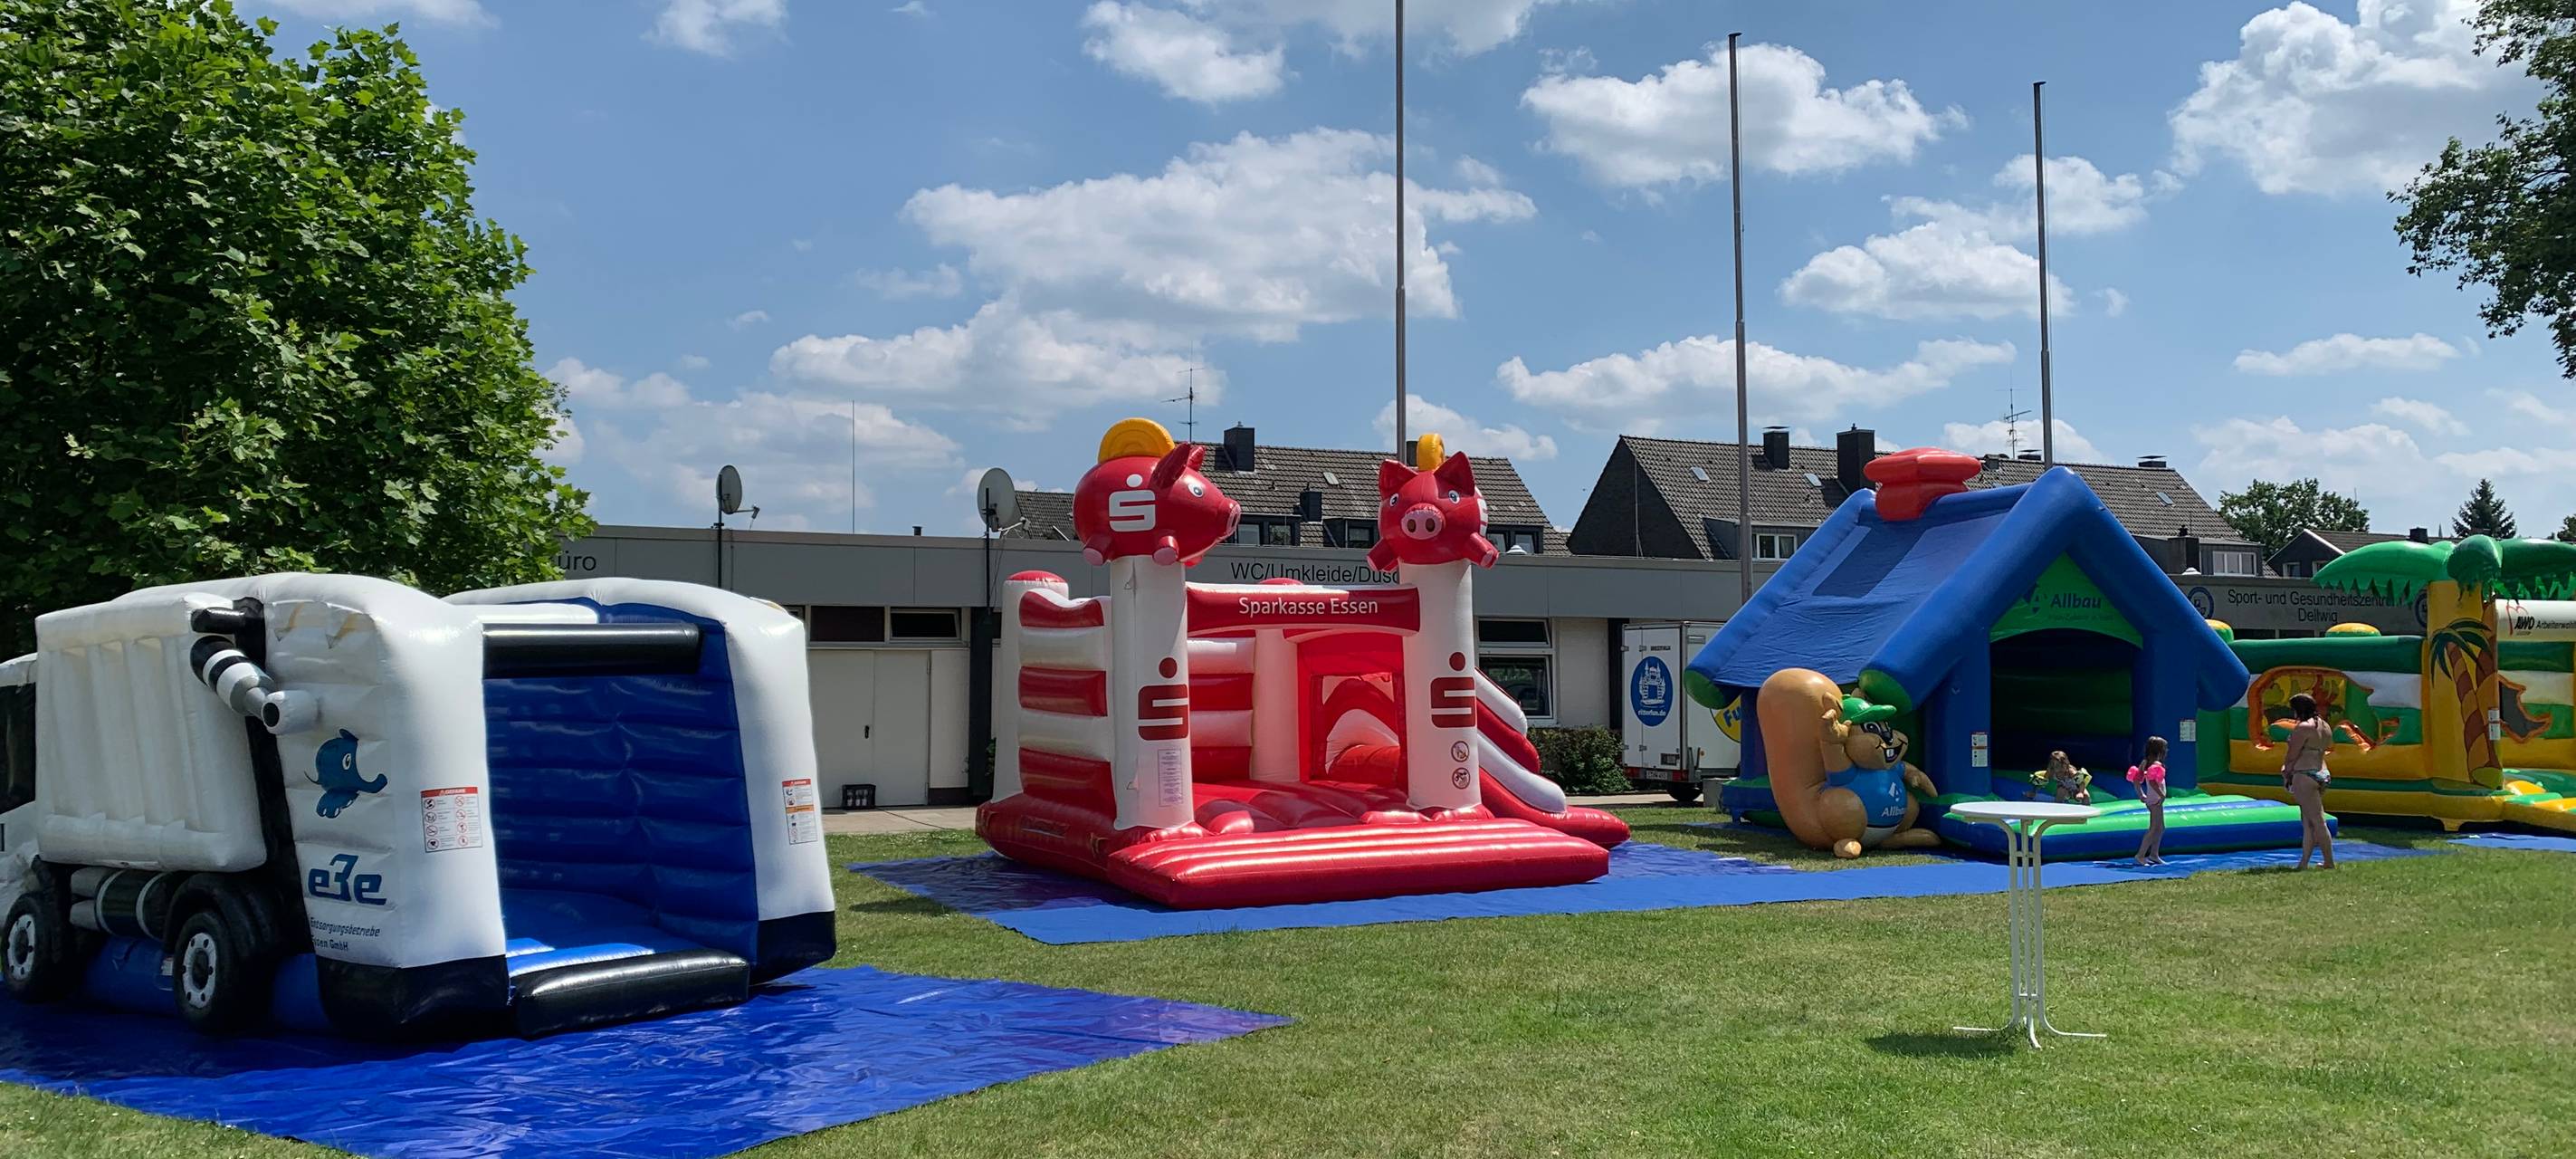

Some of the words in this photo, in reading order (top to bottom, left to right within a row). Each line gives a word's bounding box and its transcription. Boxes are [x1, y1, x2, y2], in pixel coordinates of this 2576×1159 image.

[2050, 592, 2102, 609] Allbau
[2228, 589, 2262, 606] Sport-
[2266, 590, 2286, 605] und
[1239, 597, 1326, 618] Sparkasse
[1330, 599, 1379, 615] Essen
[2298, 608, 2338, 622] Dellwig
[2514, 616, 2534, 630] AWO
[310, 916, 380, 937] Entsorgungsbetriebe
[329, 939, 349, 952] GmbH
